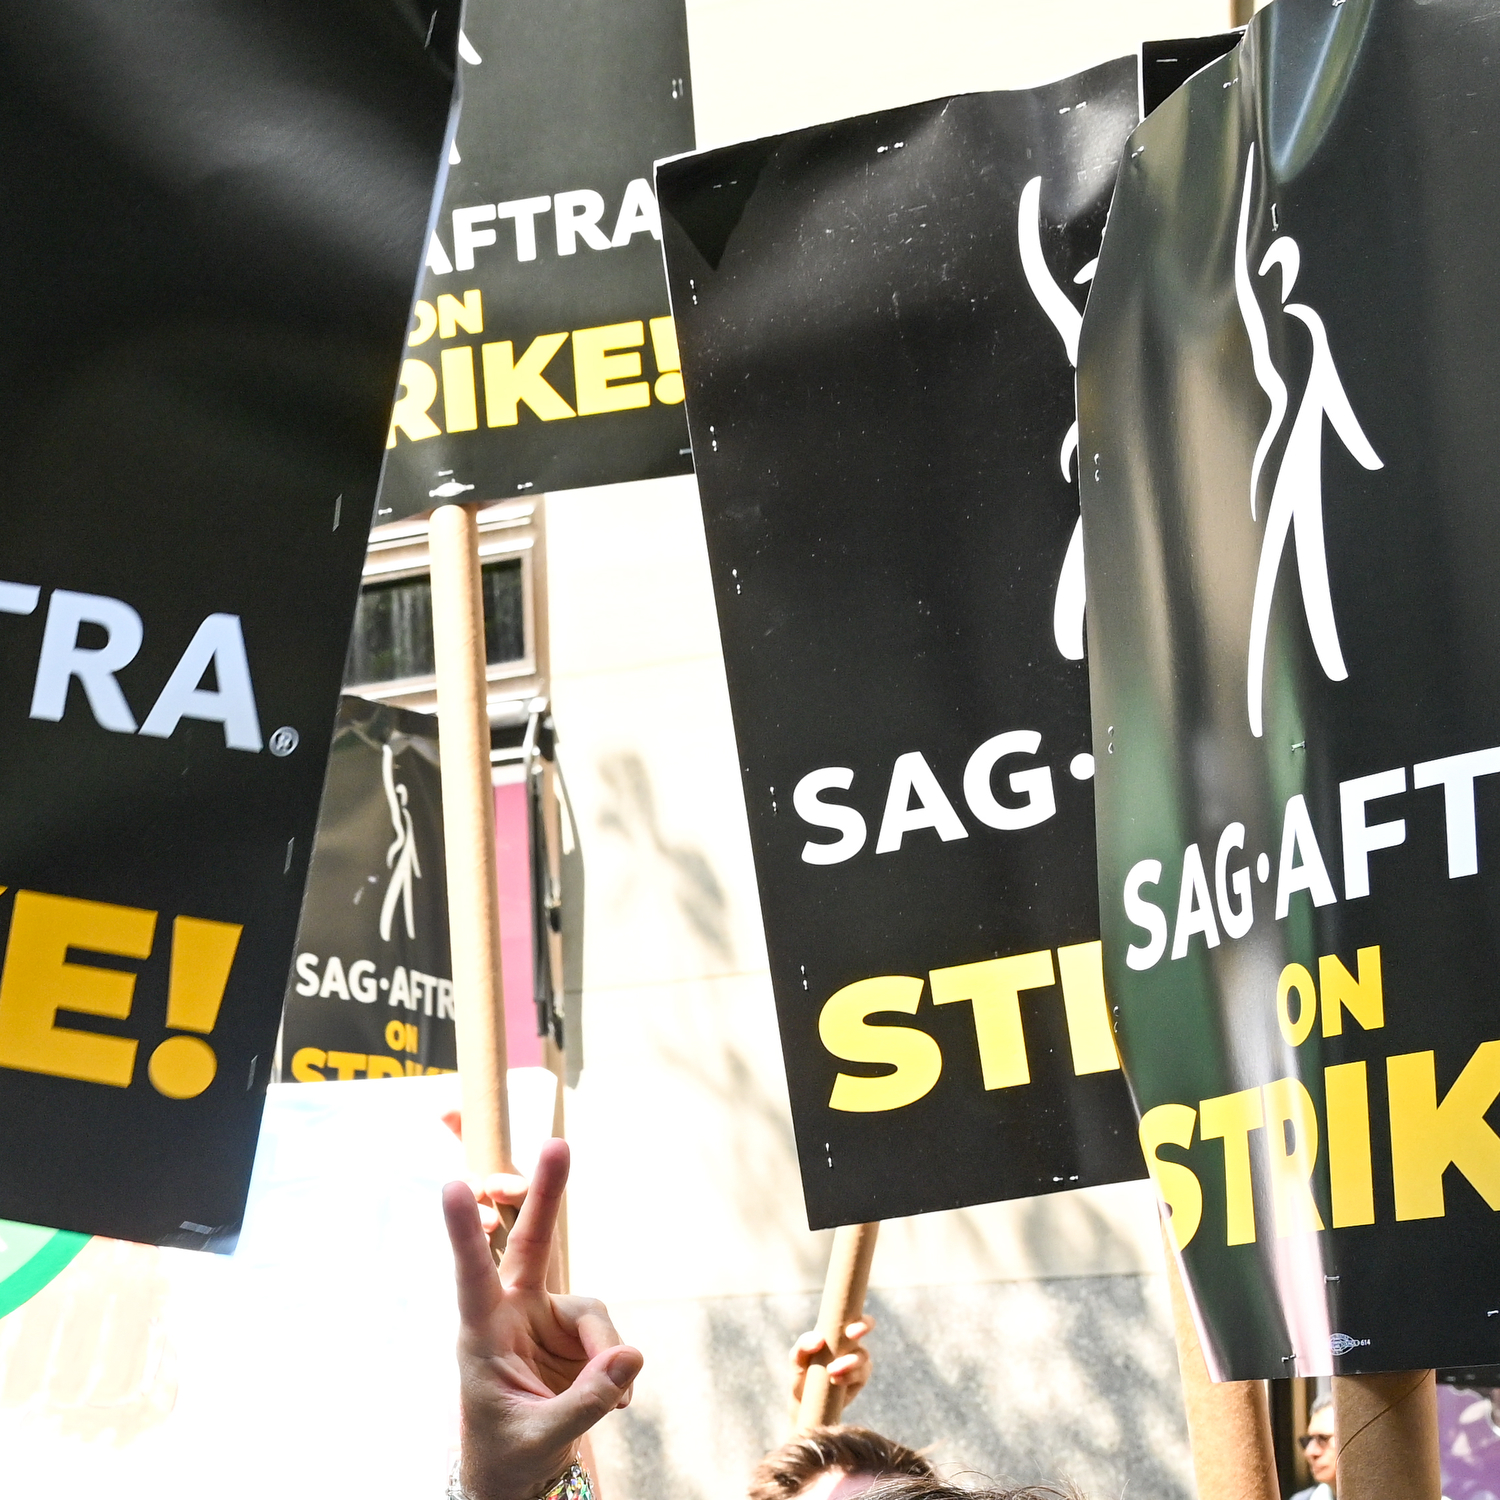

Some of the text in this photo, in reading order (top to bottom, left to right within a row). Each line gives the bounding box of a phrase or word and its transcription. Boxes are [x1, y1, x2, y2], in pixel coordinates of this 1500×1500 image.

[385, 1020, 418, 1054] ON
[1277, 945, 1384, 1047] ON
[1139, 1041, 1500, 1254] STRIK
